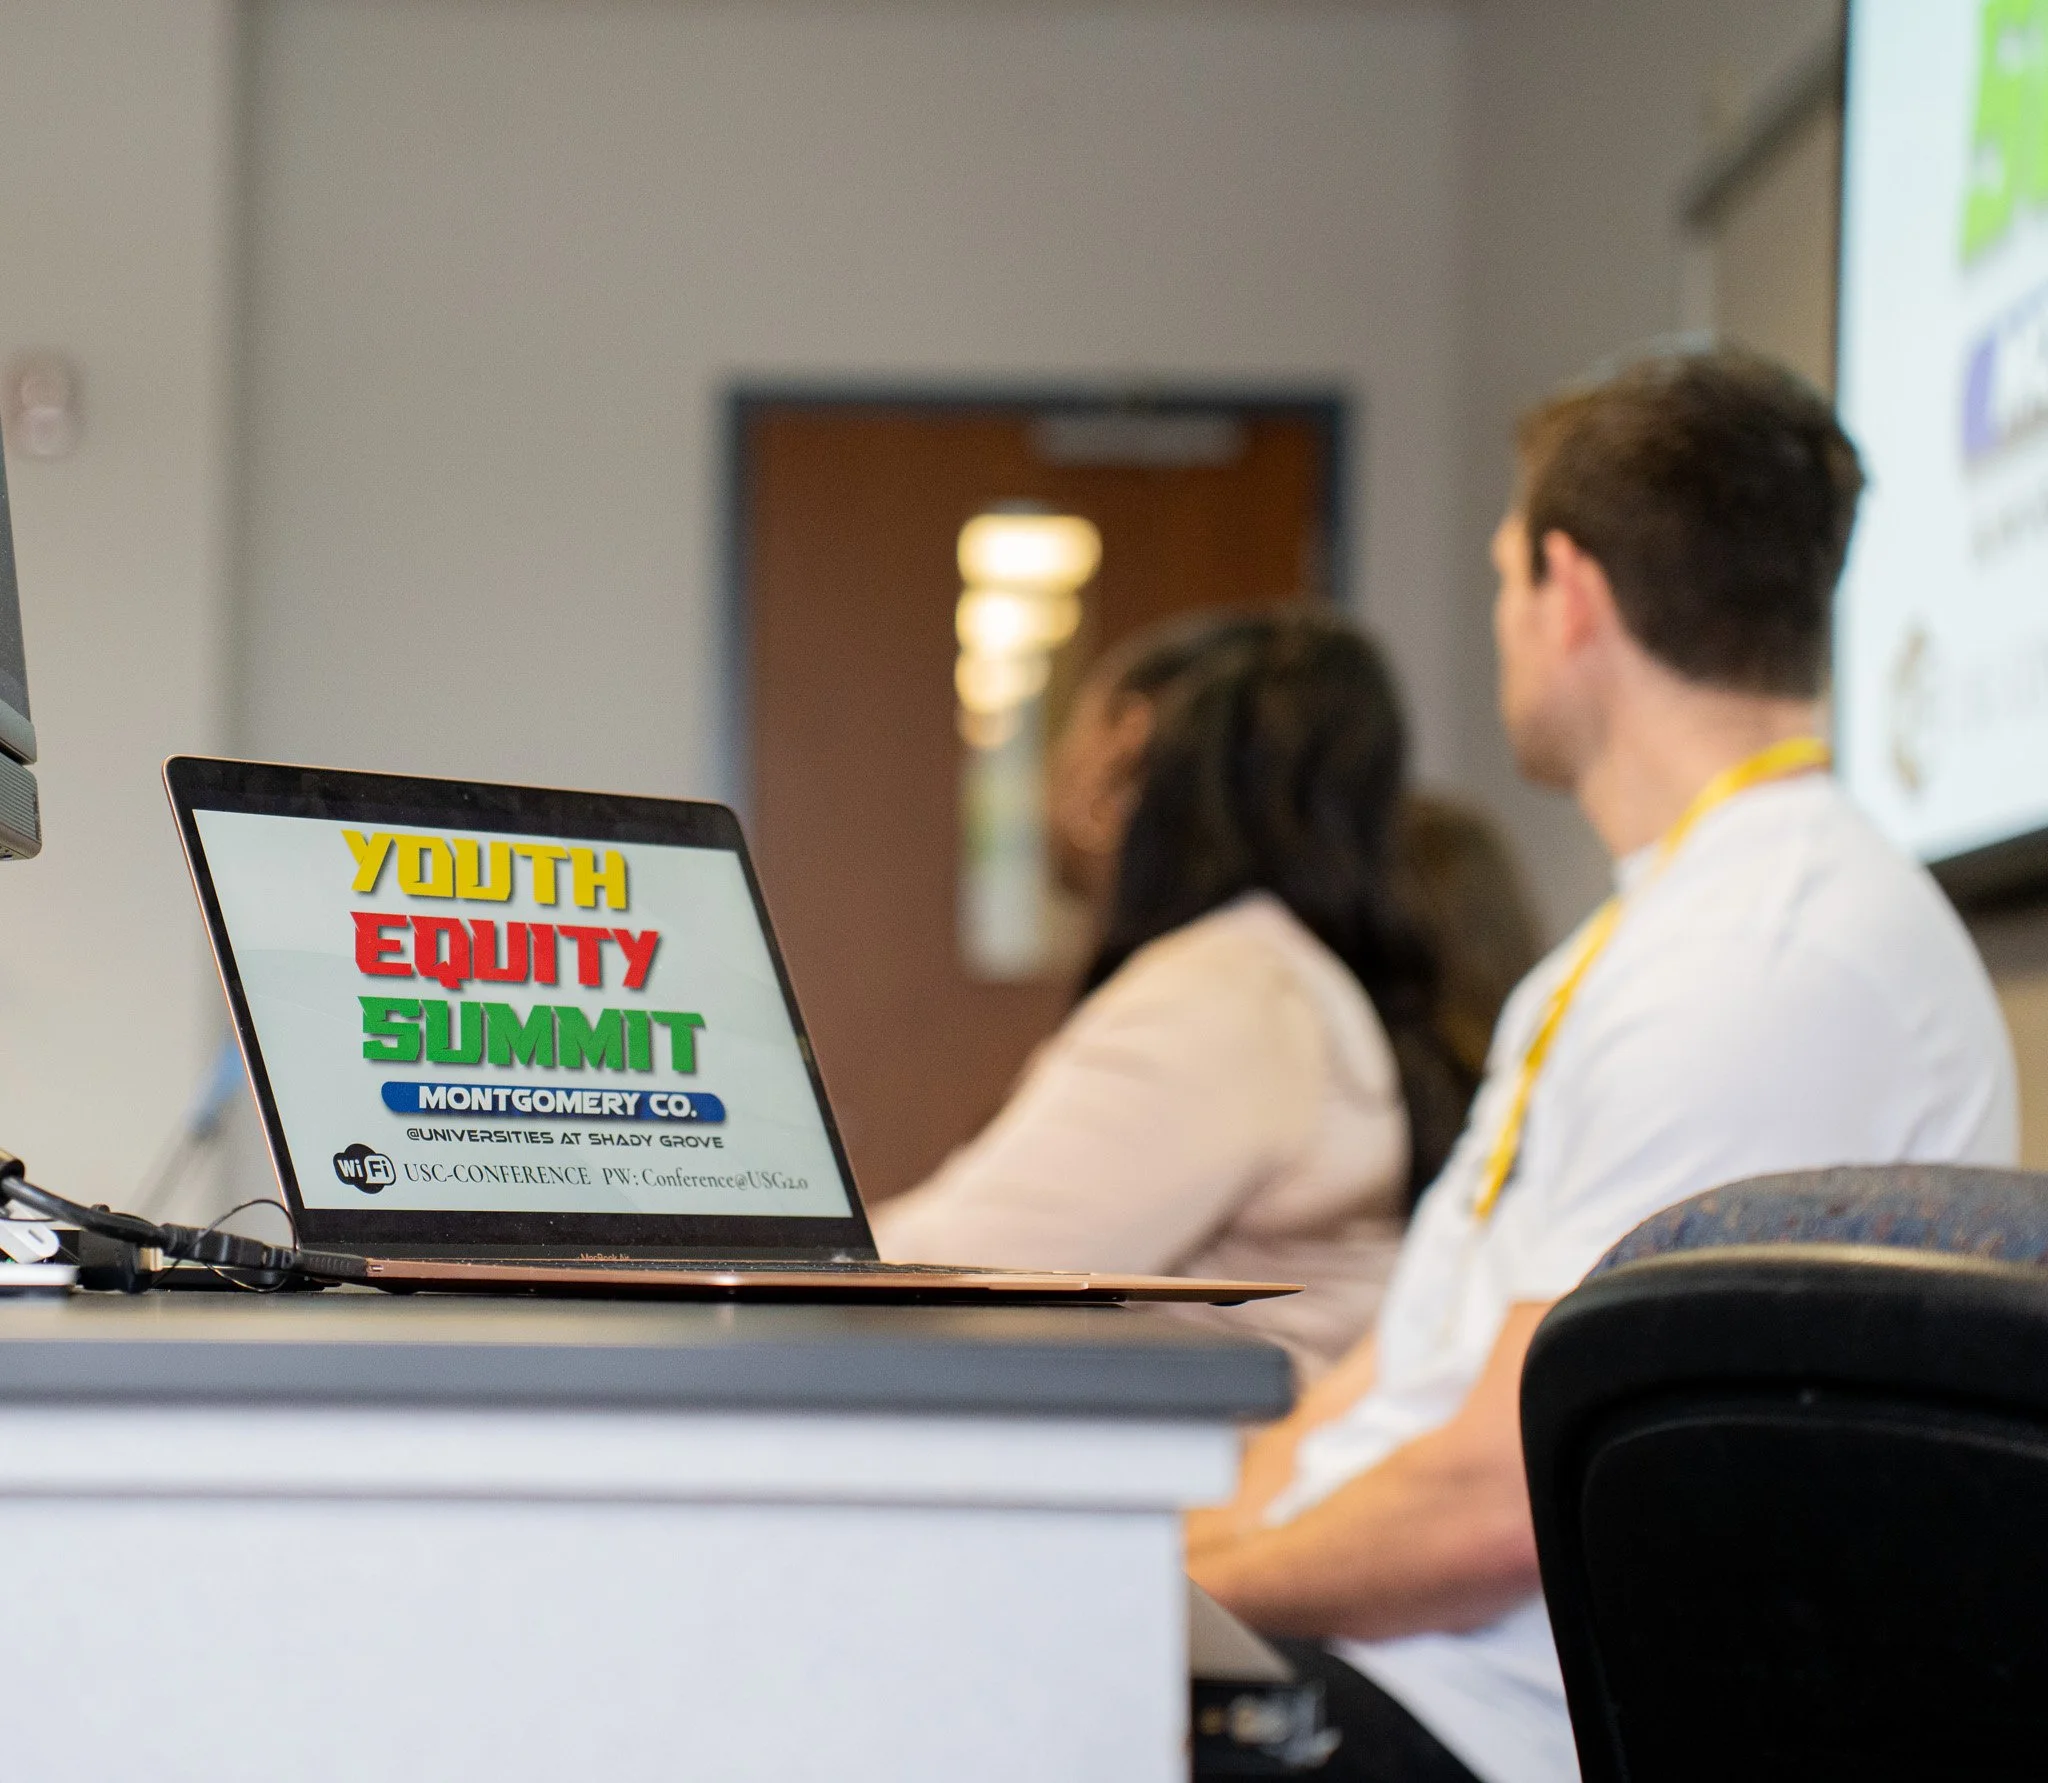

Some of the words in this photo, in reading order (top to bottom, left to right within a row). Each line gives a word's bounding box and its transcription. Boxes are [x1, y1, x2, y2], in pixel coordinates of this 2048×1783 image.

[341, 830, 627, 910] YOUTH
[349, 911, 660, 989] EQUITY
[357, 996, 706, 1073] SUMMIT
[406, 1128, 554, 1145] @UNIVERSITIES
[560, 1132, 582, 1146] AT
[588, 1133, 652, 1147] SHADY
[659, 1135, 725, 1149] GROVE
[418, 1086, 641, 1117] MONTGOMERY
[650, 1094, 698, 1118] CO.
